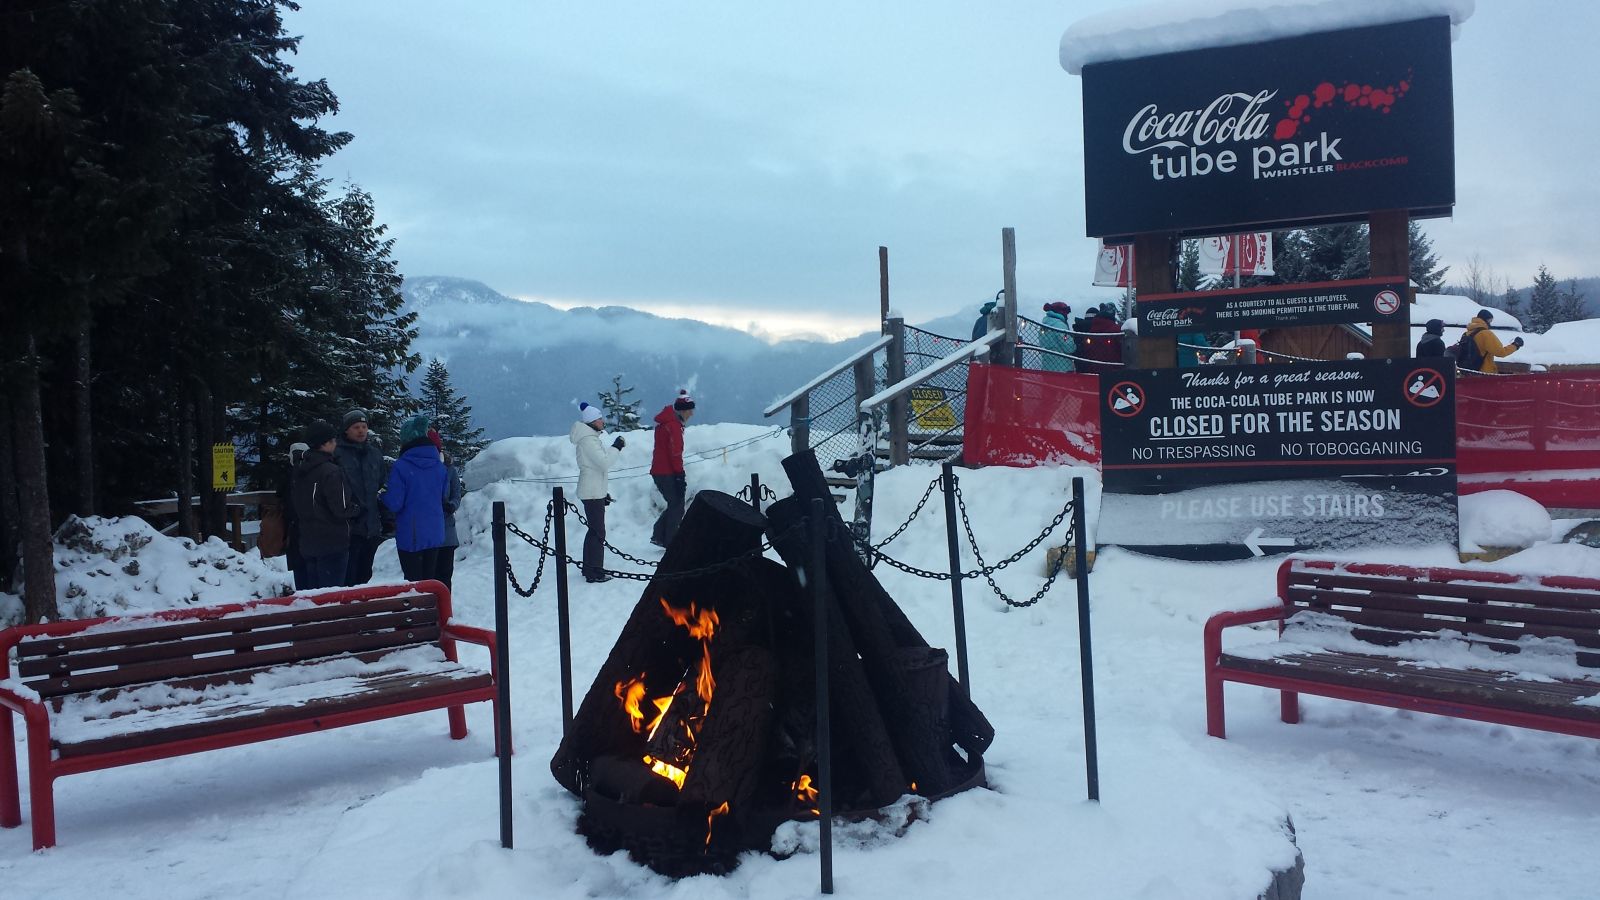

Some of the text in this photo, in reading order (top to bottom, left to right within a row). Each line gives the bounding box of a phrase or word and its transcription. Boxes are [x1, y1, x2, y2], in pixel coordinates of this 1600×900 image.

[1123, 88, 1279, 154] Coca-Cola
[1150, 132, 1343, 181] tube park
[1262, 156, 1408, 179] WHISTLER BLACKCOMB
[1216, 310, 1233, 318] THERE
[1242, 309, 1250, 317] NO
[1250, 308, 1275, 316] SMOKING
[1276, 305, 1307, 314] PERMITTED
[1308, 304, 1315, 312] AT
[1316, 304, 1327, 312] THE
[1328, 303, 1342, 311] TUBE
[1239, 299, 1266, 308] COURTESY
[1286, 296, 1307, 305] GUESTS
[1152, 319, 1172, 327] tube
[1173, 317, 1193, 327] park
[1181, 370, 1364, 389] Thanks for a great season.
[911, 389, 944, 400] CLOSED
[1171, 389, 1375, 410] THE COCA-COLA TUBE PARK IS NOW
[1150, 408, 1401, 437] CLOSED FOR THE SEASON
[1132, 441, 1422, 460] NO TRESPASSING NO TOBOGGANING
[1161, 493, 1385, 520] PLEASE USE STAIRS
